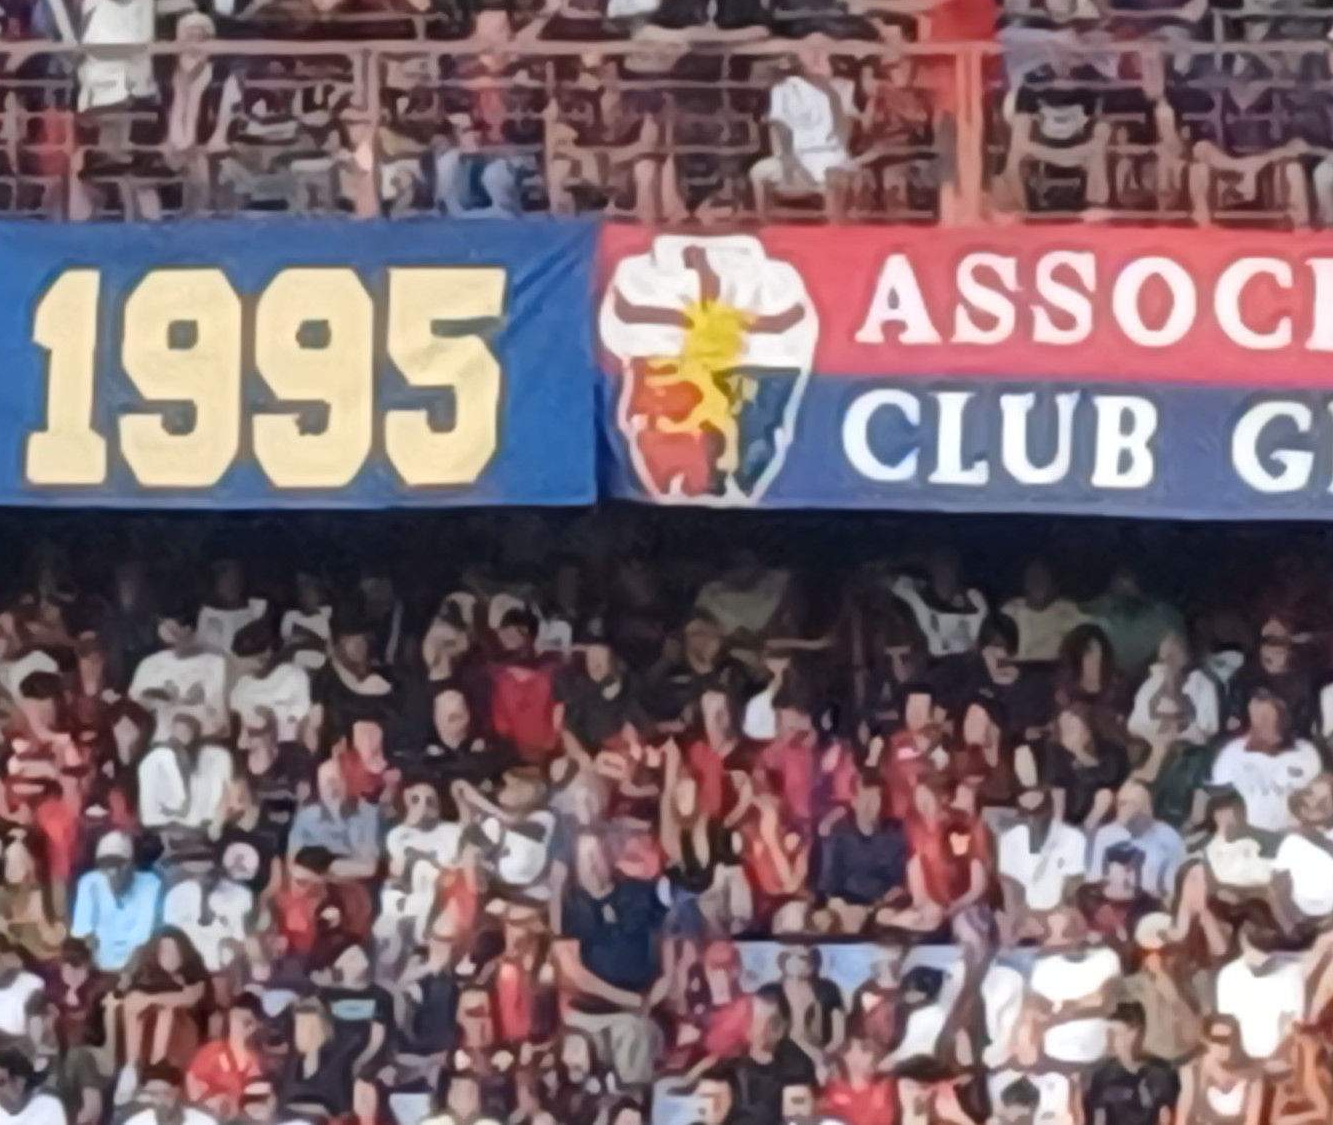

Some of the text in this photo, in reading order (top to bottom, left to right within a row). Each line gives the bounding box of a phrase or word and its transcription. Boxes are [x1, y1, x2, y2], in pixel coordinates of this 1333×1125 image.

[26, 267, 507, 488] 1995
[842, 388, 1333, 494] CLUB G
